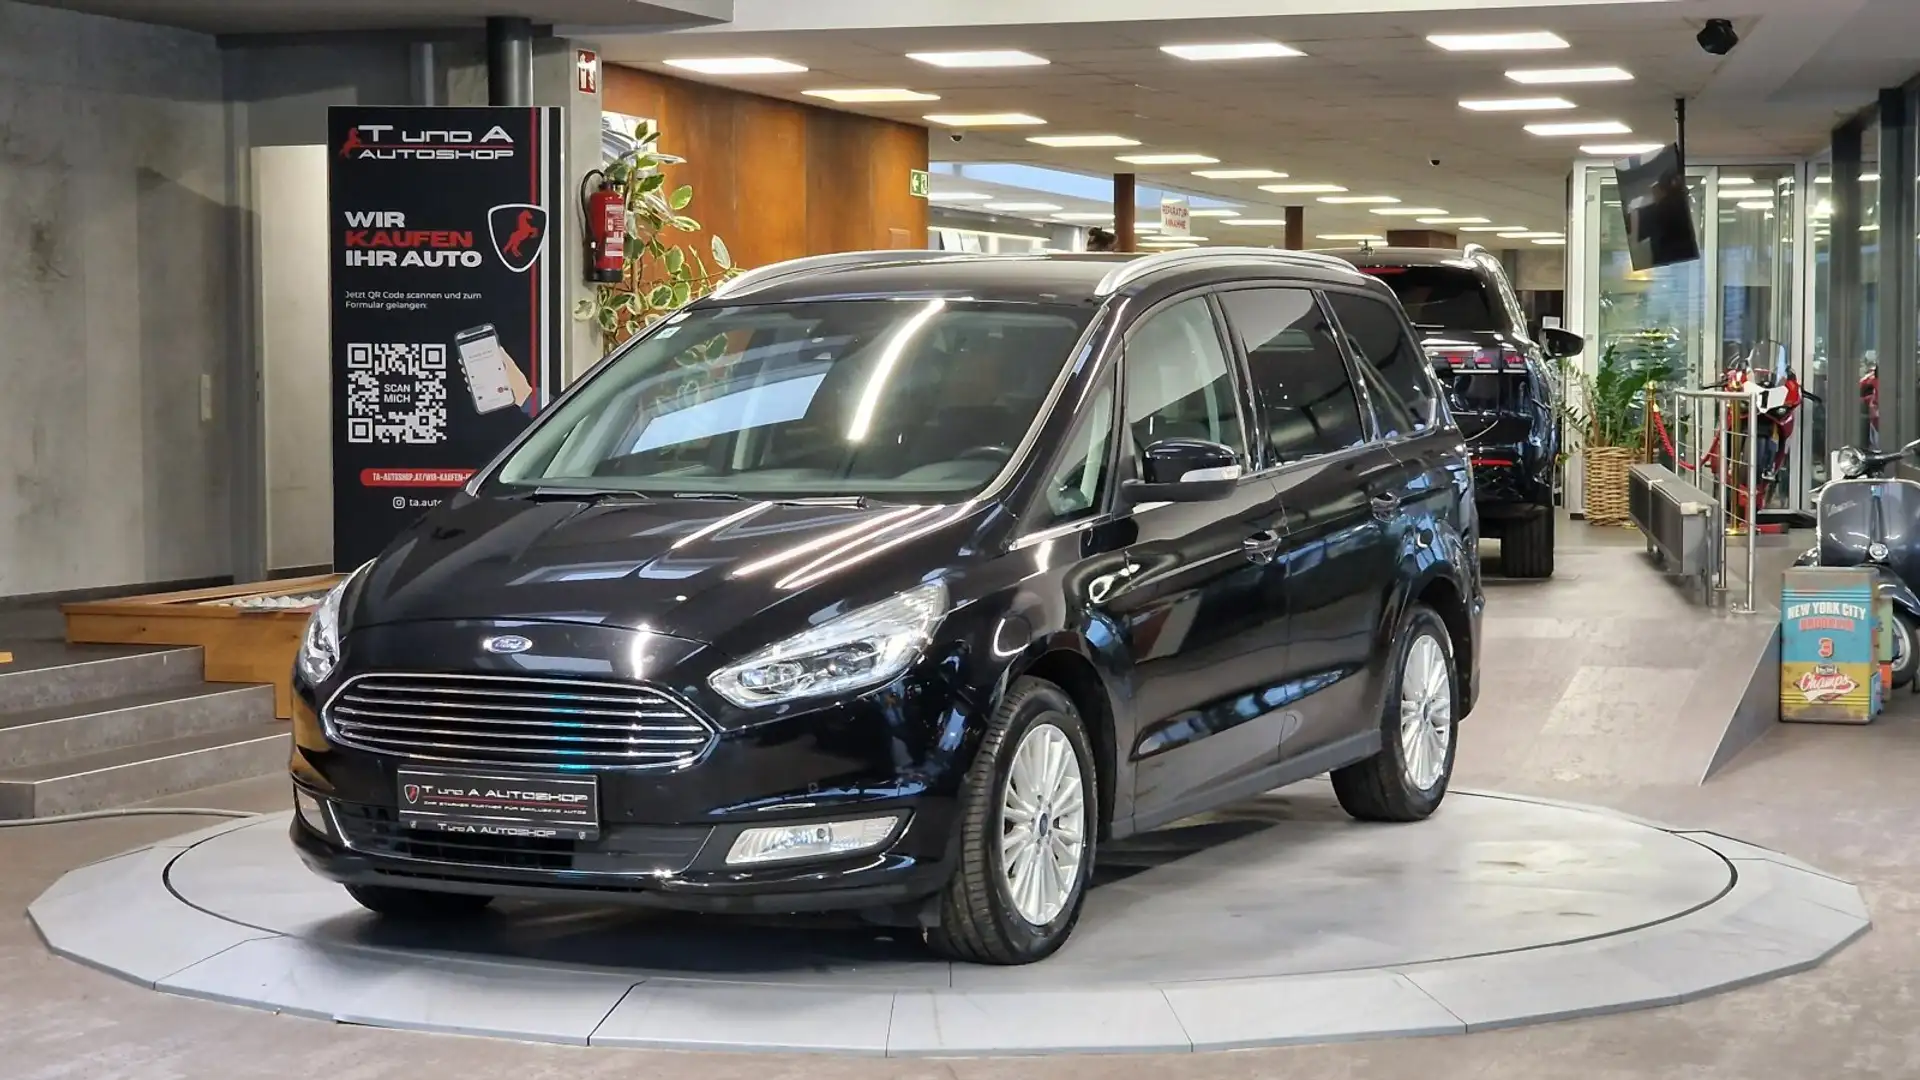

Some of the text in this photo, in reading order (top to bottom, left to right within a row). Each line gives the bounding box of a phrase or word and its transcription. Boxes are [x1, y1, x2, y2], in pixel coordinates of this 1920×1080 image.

[358, 125, 393, 142] T
[480, 125, 514, 143] A
[358, 149, 514, 160] AUTOSHOP
[345, 211, 406, 228] WIR
[345, 231, 473, 248] KAUFEN
[345, 250, 483, 267] IHR AUTO
[345, 291, 366, 299] Jetzt
[367, 291, 381, 300] QR
[382, 291, 405, 299] Code
[406, 291, 442, 299] scannen
[444, 291, 461, 299] und
[345, 301, 427, 310] Formular gelangen:
[384, 384, 411, 393] SCAN
[384, 394, 411, 403] MICH
[1787, 601, 1867, 620] NEW YORK CITY
[1817, 637, 1834, 657] 3
[421, 785, 434, 794] T
[468, 789, 480, 797] A
[485, 790, 588, 802] AUTOSHOP
[480, 826, 557, 838] AUTOSHOP
